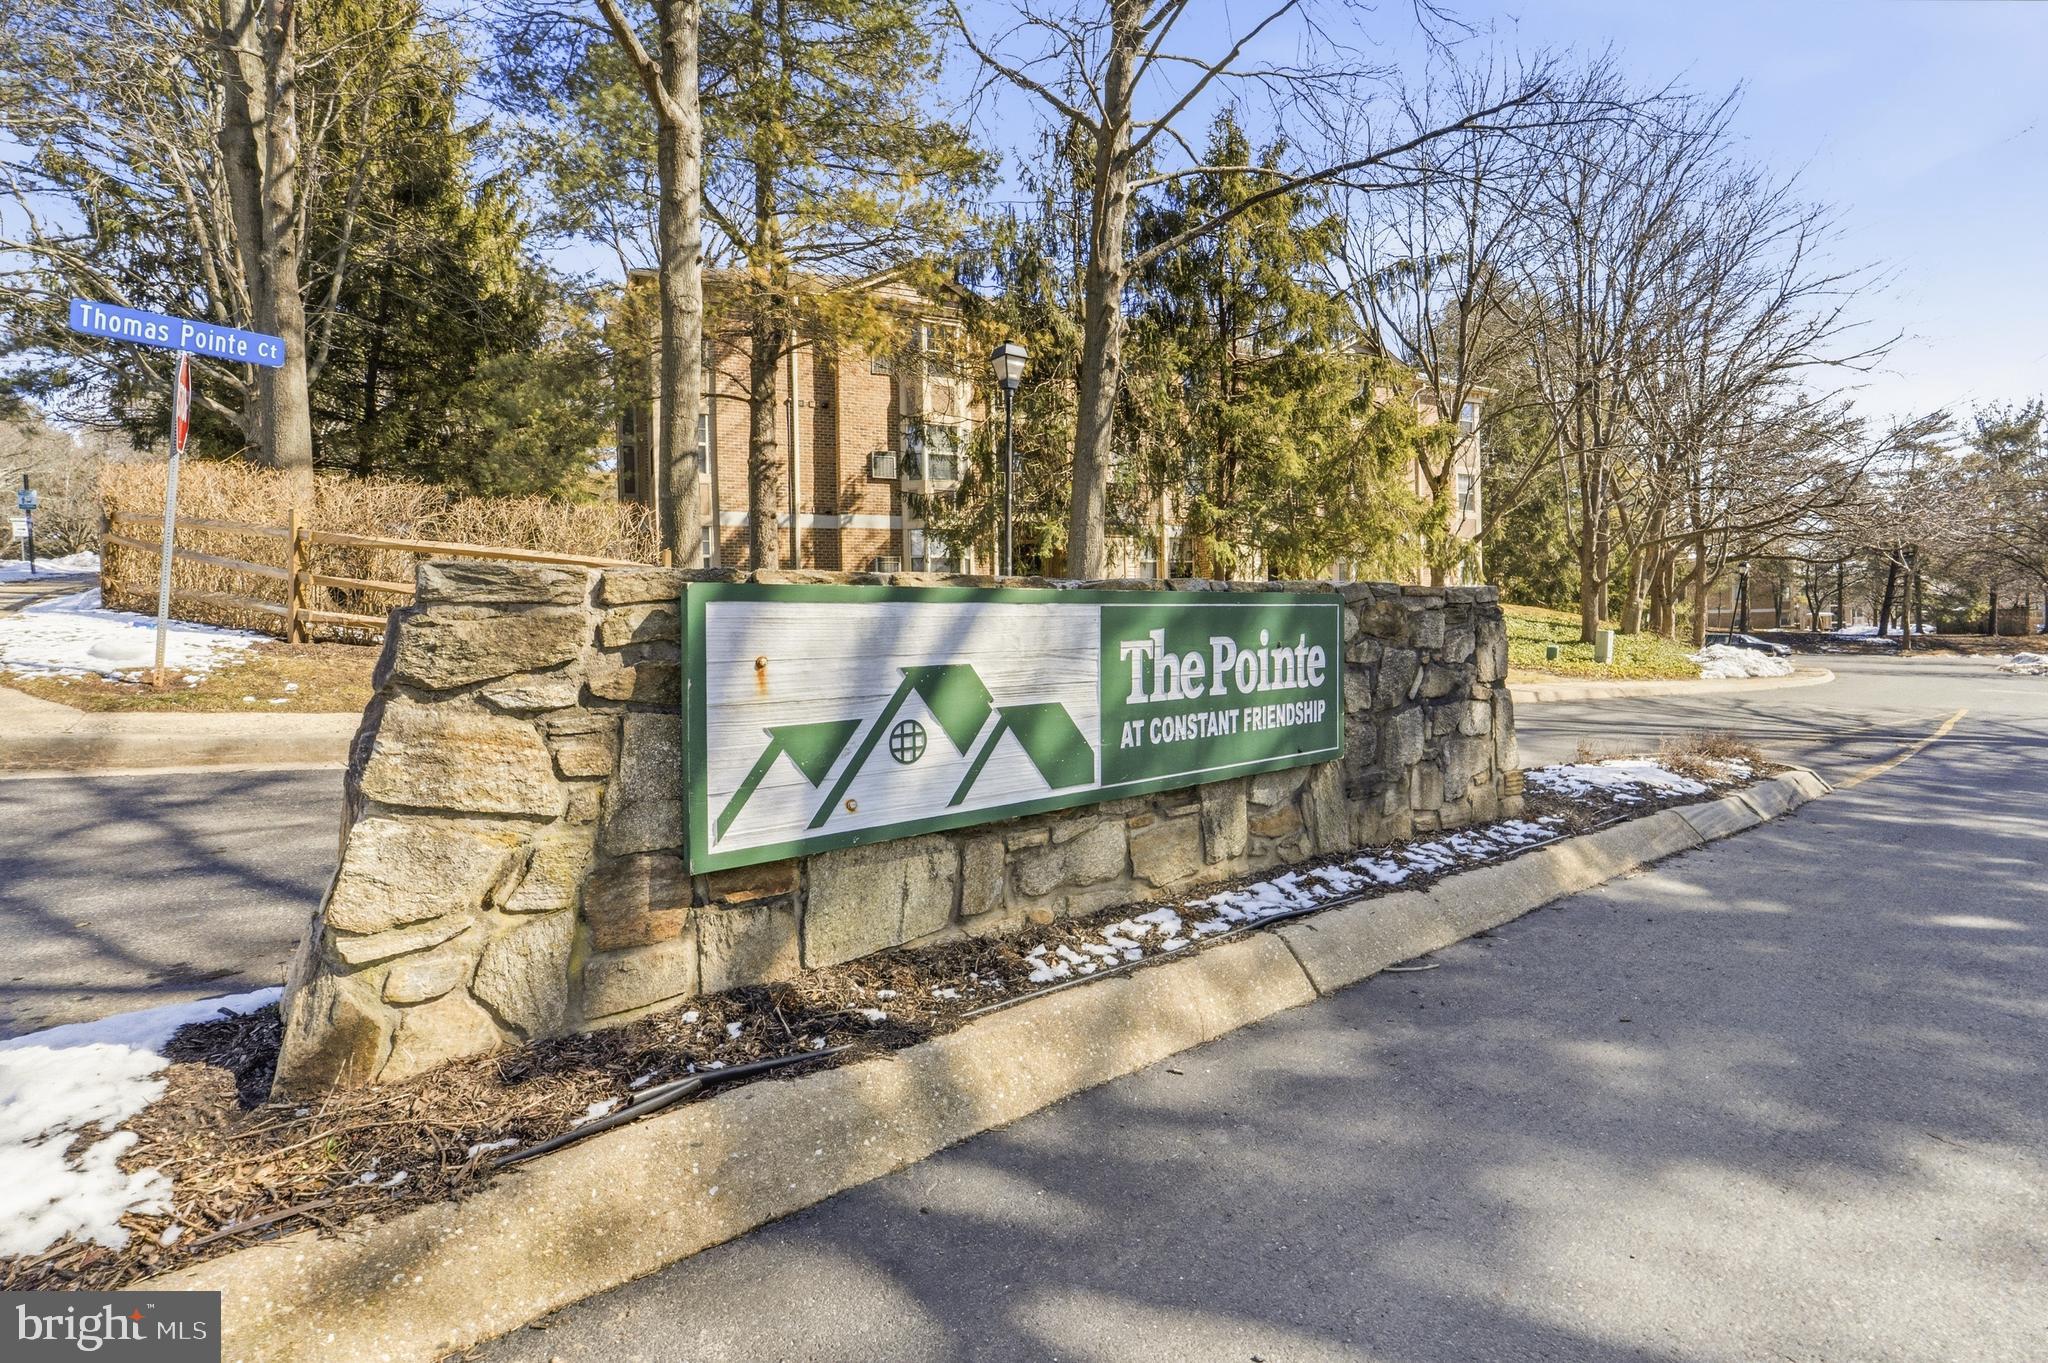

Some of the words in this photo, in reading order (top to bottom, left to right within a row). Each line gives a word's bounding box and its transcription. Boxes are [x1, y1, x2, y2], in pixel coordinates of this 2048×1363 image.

[79, 303, 169, 342] Thomas
[180, 323, 248, 356] Pointe
[258, 342, 278, 359] Ct
[1120, 627, 1206, 705] The
[1209, 628, 1326, 696] Pointe
[1120, 719, 1145, 749] AT
[1150, 708, 1240, 745] CONSTANT
[1243, 699, 1326, 733] FRIENDSHIP
